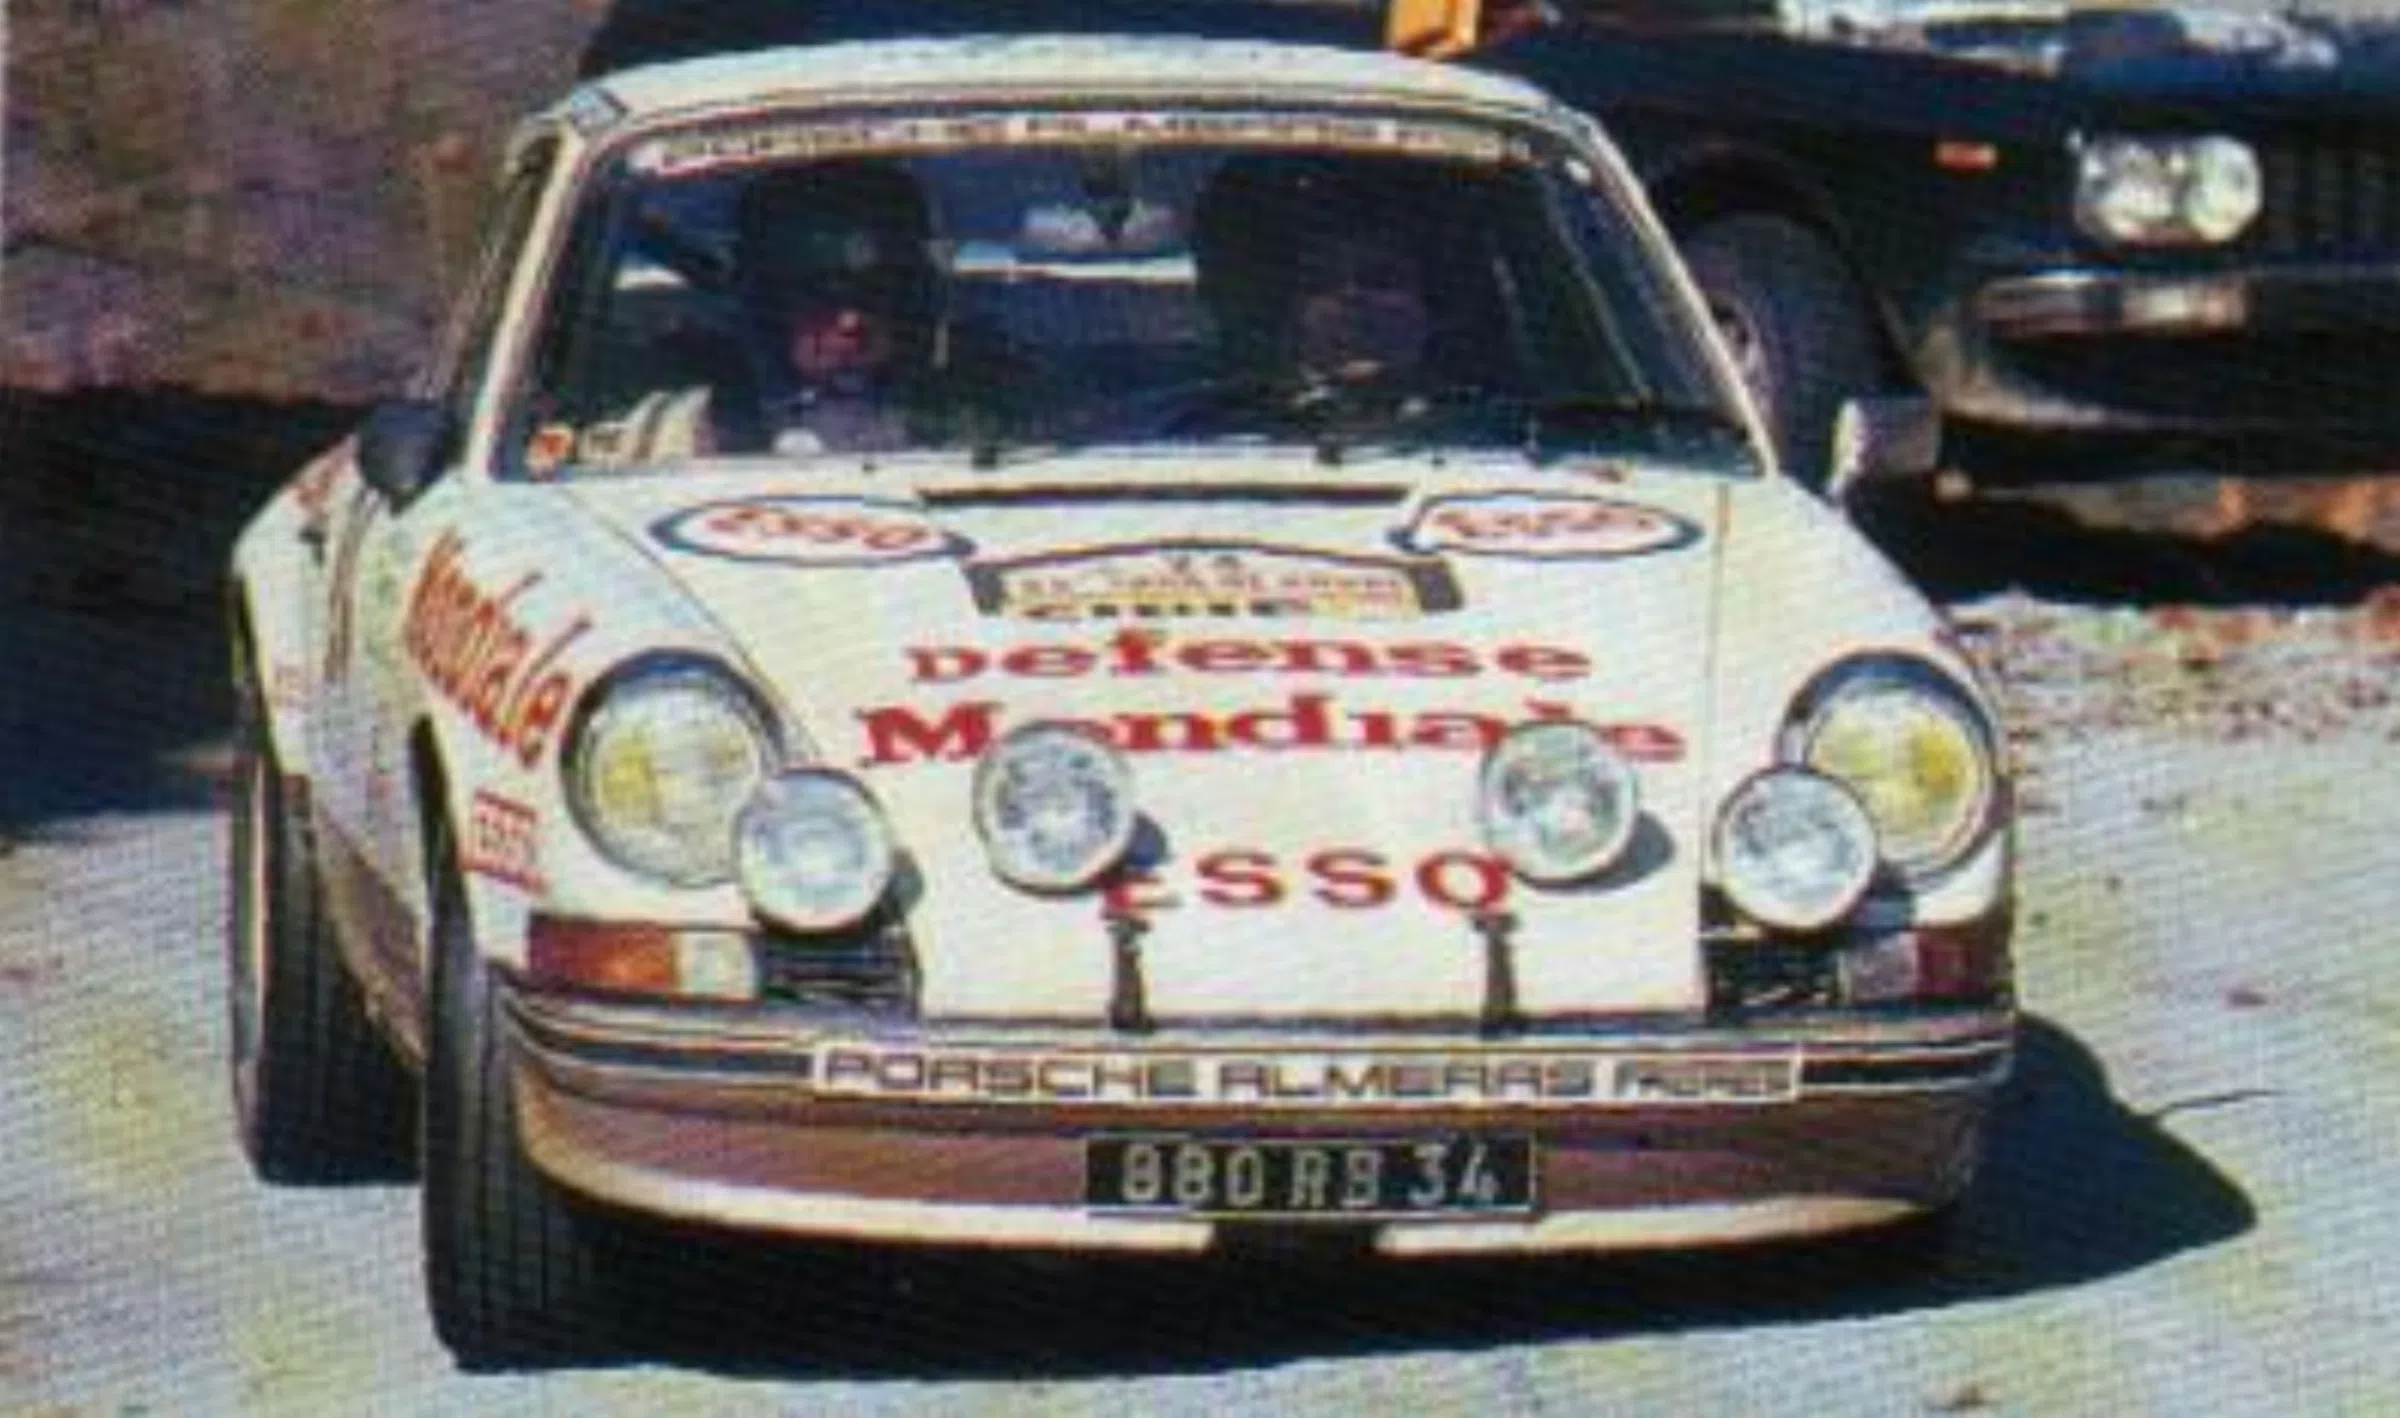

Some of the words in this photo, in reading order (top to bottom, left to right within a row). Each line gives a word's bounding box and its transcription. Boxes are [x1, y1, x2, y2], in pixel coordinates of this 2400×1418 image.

[826, 1050, 1198, 1098] PORSCHE
[1219, 1058, 1594, 1098] ALMERAS
[1121, 1142, 1264, 1208] 880
[1407, 1141, 1500, 1207] 34
